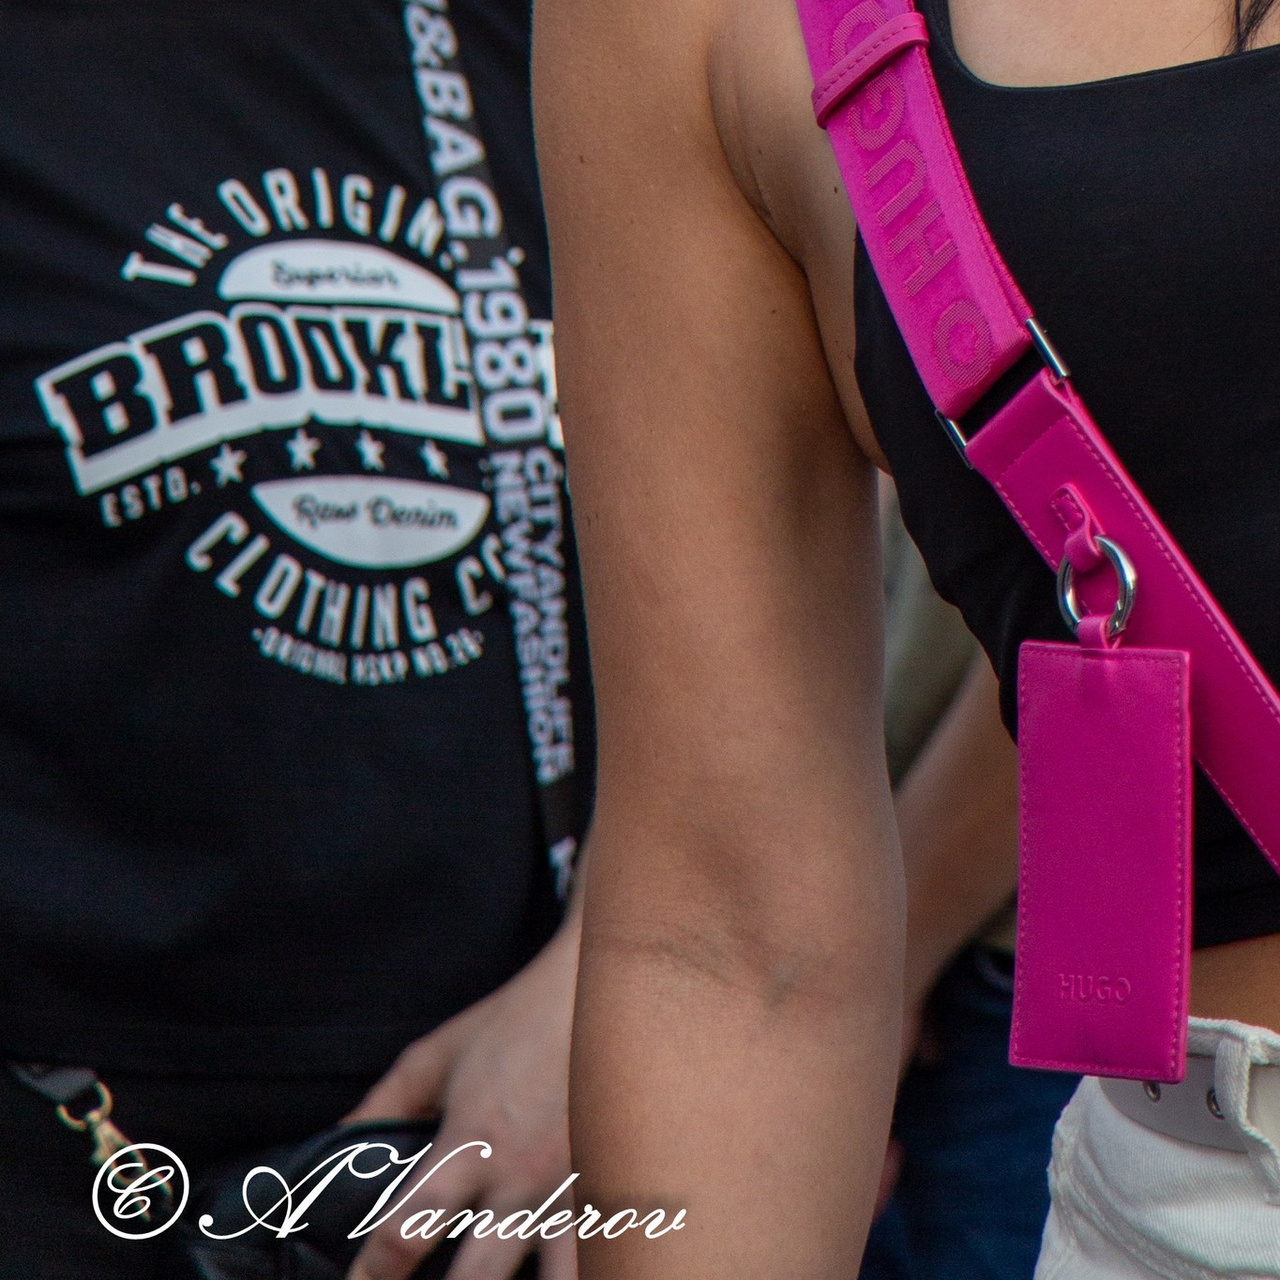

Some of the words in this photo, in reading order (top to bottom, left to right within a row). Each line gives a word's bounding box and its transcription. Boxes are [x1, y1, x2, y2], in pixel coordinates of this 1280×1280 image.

[121, 202, 229, 287] THE
[217, 167, 453, 270] ORIGIN
[34, 302, 565, 496] BROOKL
[185, 510, 439, 650] CLOTHING
[1058, 972, 1131, 1006] HUGO
